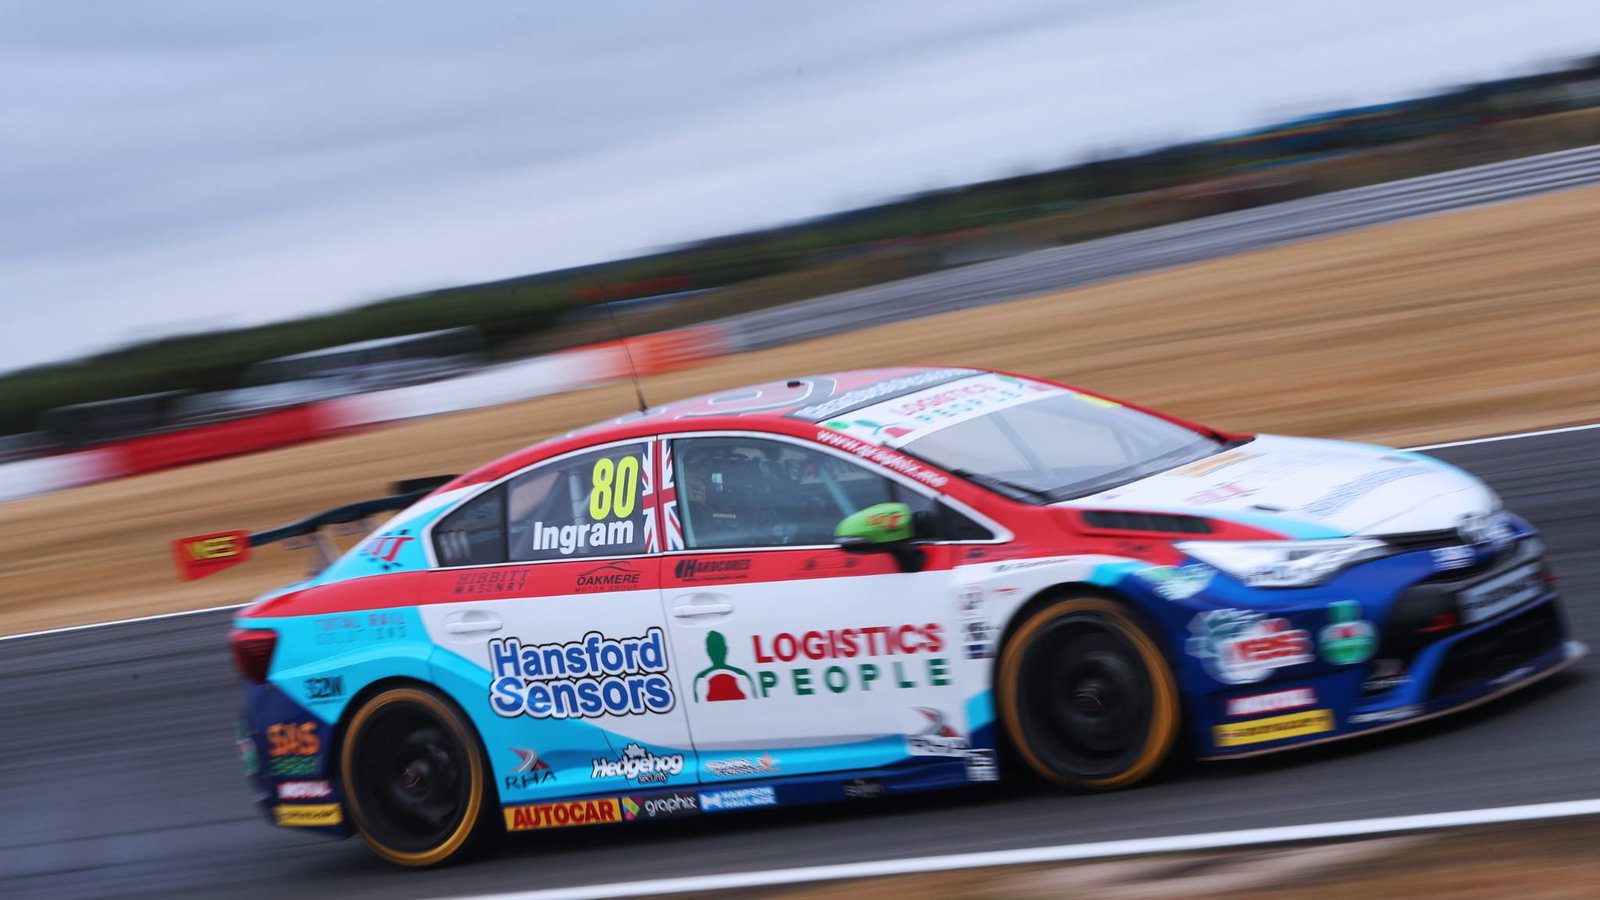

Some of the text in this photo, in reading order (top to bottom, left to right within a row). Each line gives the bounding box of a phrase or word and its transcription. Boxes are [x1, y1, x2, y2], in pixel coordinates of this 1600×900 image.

[589, 456, 639, 521] 80
[533, 520, 634, 554] Ingram
[576, 573, 641, 586] OAKMERE
[489, 629, 667, 680] Hansford
[752, 623, 945, 664] LOGISTICS
[757, 658, 952, 698] PEOPLE
[491, 674, 673, 717] Sensors
[505, 769, 557, 790] RHA
[591, 752, 684, 779] Hedgehog
[512, 801, 616, 830] AUTOCAR
[645, 794, 697, 817] graphix
